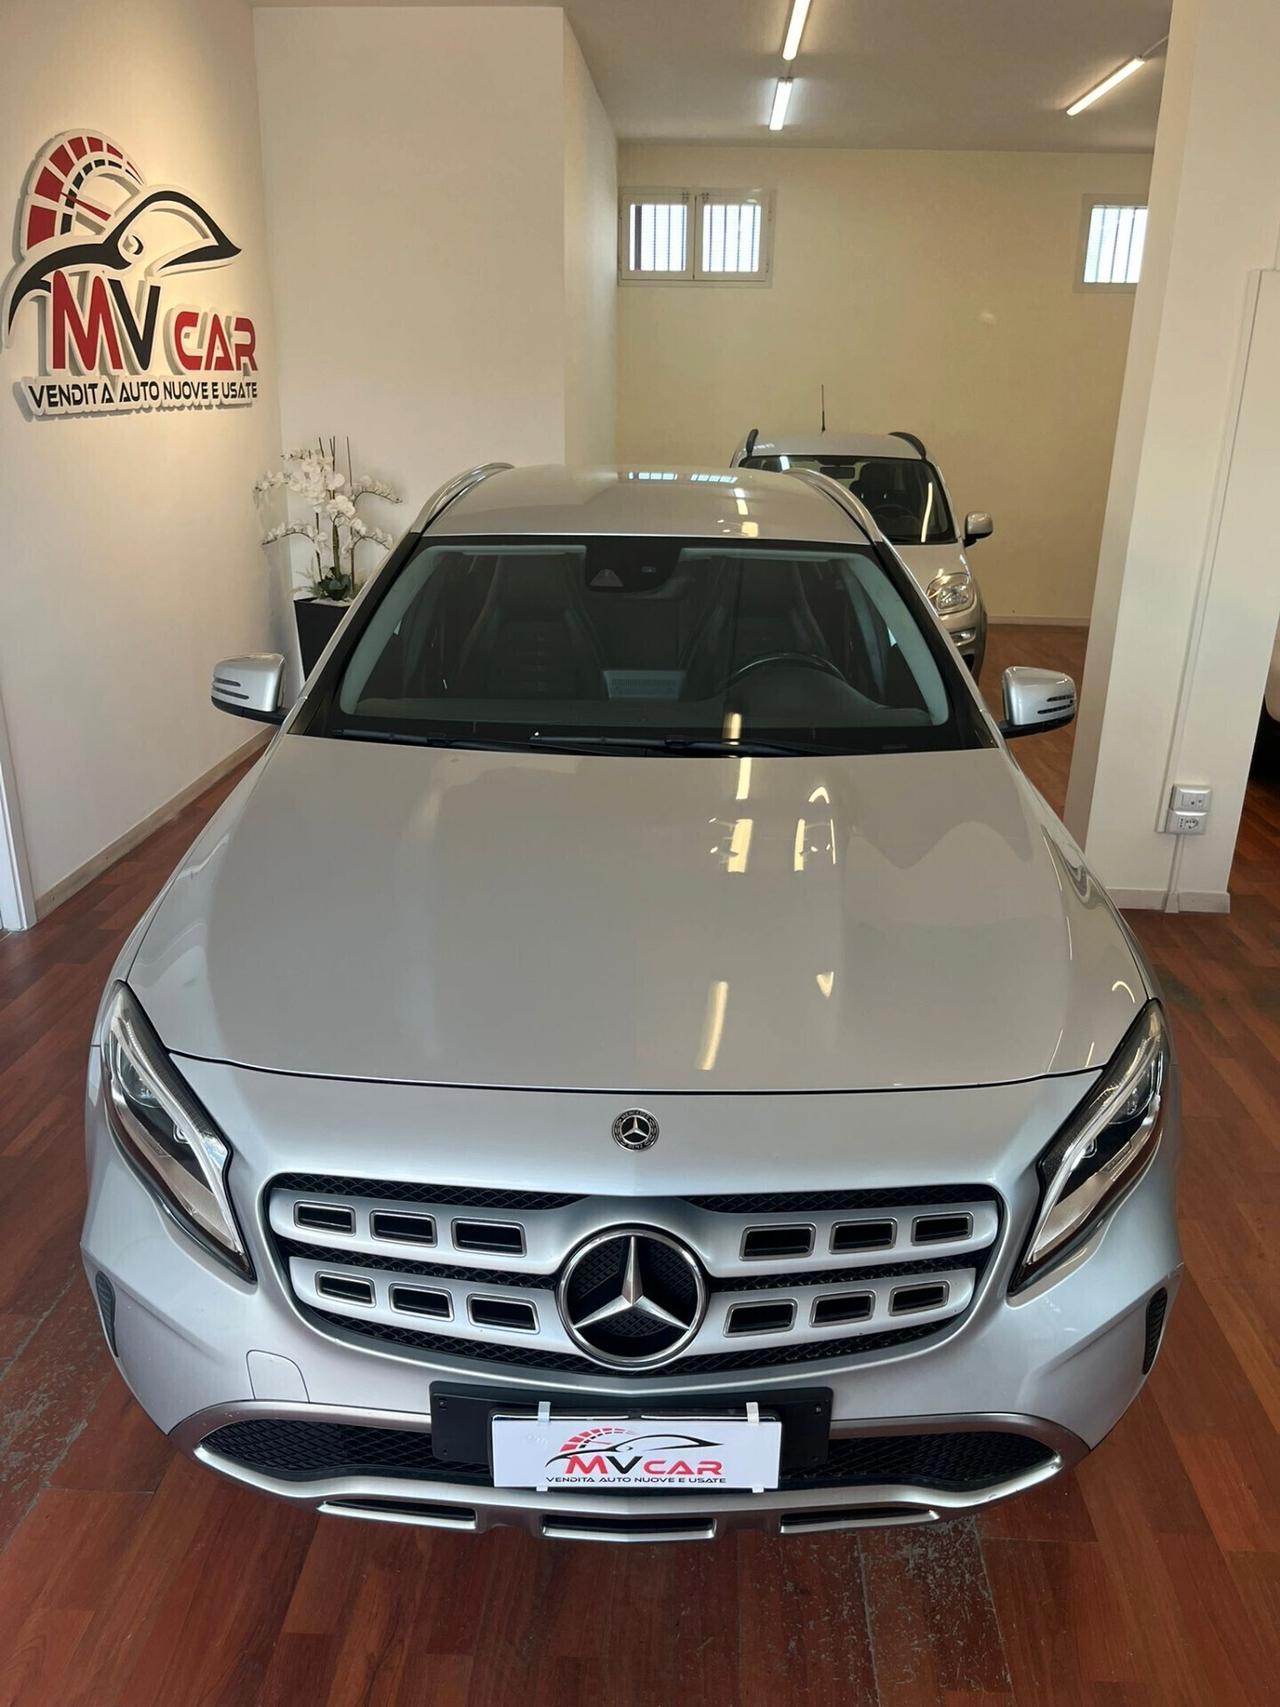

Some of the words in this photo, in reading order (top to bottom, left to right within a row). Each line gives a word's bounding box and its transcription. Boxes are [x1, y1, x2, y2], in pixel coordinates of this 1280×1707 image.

[28, 382, 115, 409] VENDITA
[119, 381, 160, 402] AUTO
[163, 381, 209, 401] NUOVE
[212, 381, 219, 399] E
[221, 381, 258, 399] USATE
